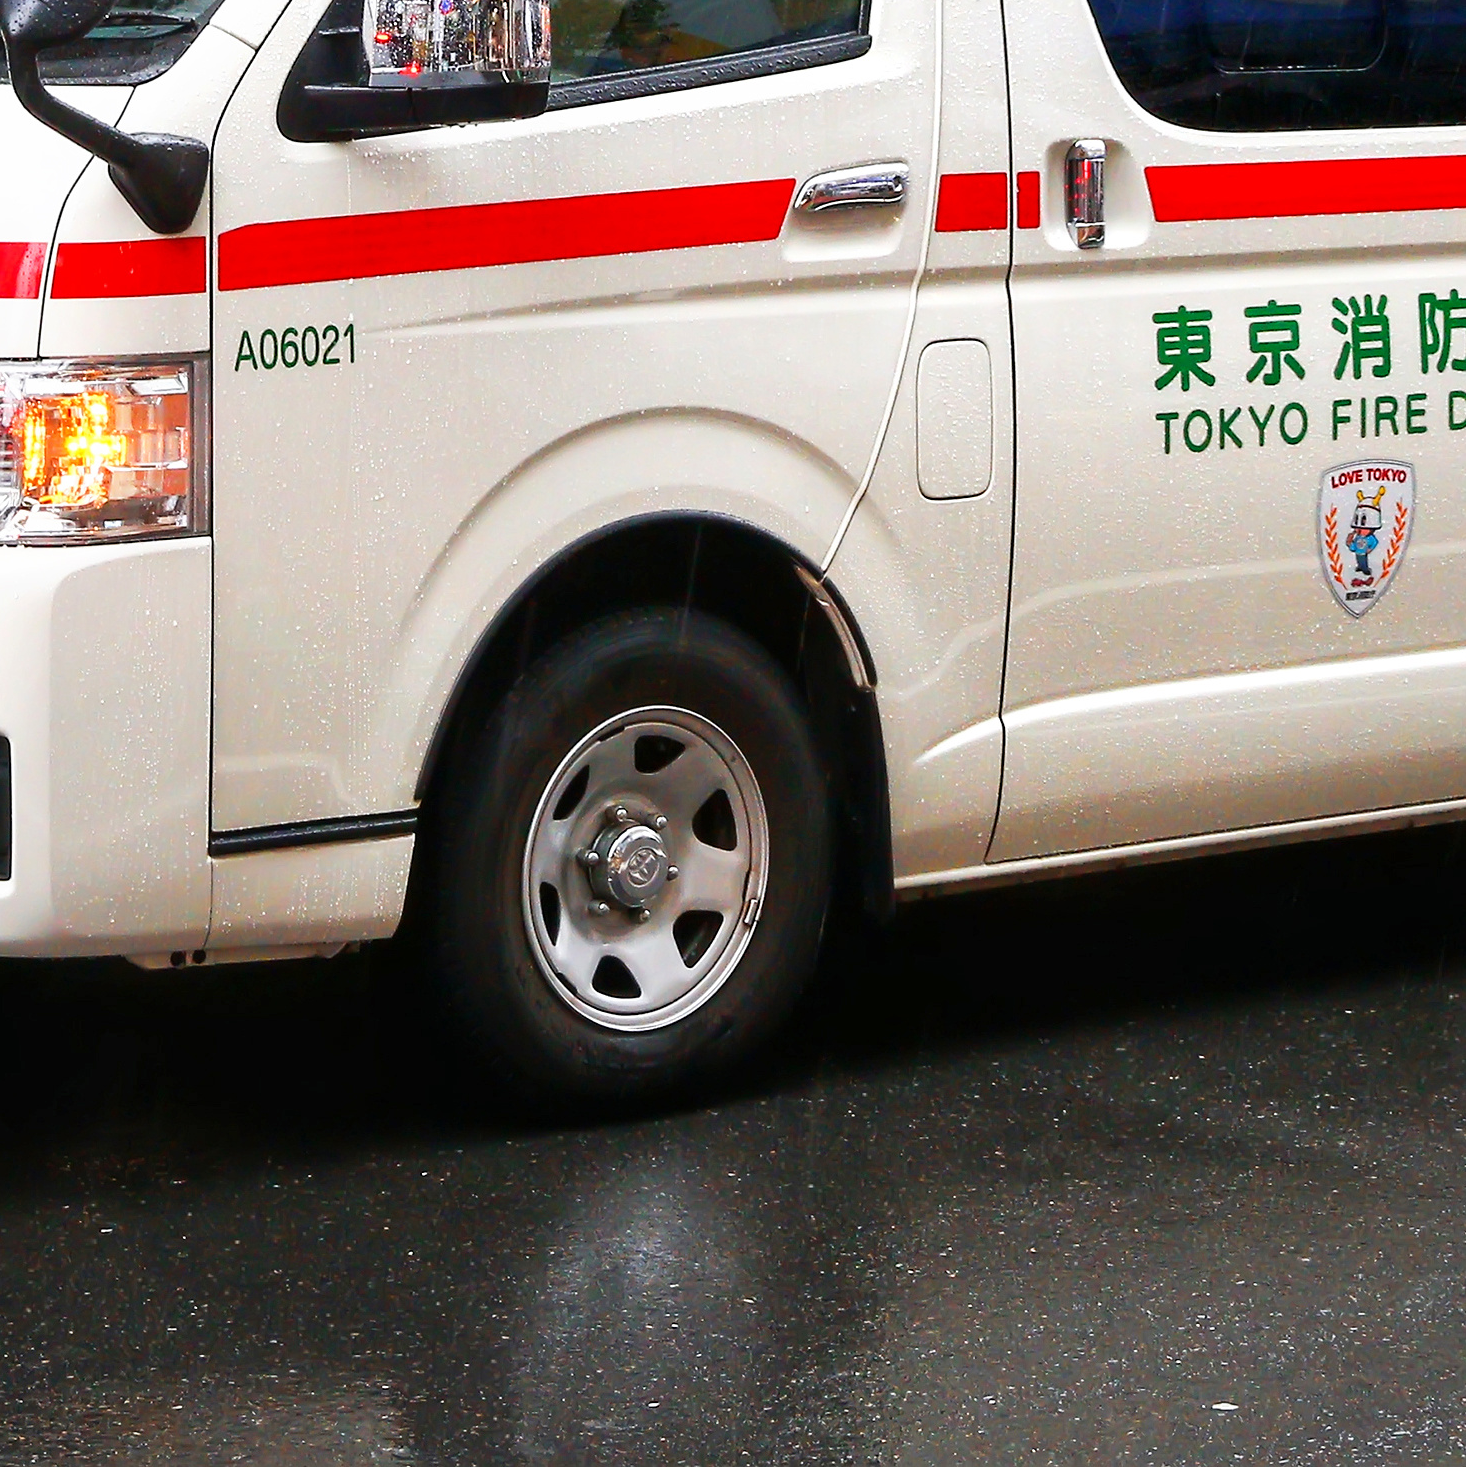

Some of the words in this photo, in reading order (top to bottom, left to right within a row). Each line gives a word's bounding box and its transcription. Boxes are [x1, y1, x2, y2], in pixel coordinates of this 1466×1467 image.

[234, 323, 355, 372] A06021
[1155, 402, 1309, 455] TOKYO
[1331, 393, 1429, 441] FIRE
[1331, 469, 1363, 490] LOVE
[1366, 467, 1407, 485] TOKYO
